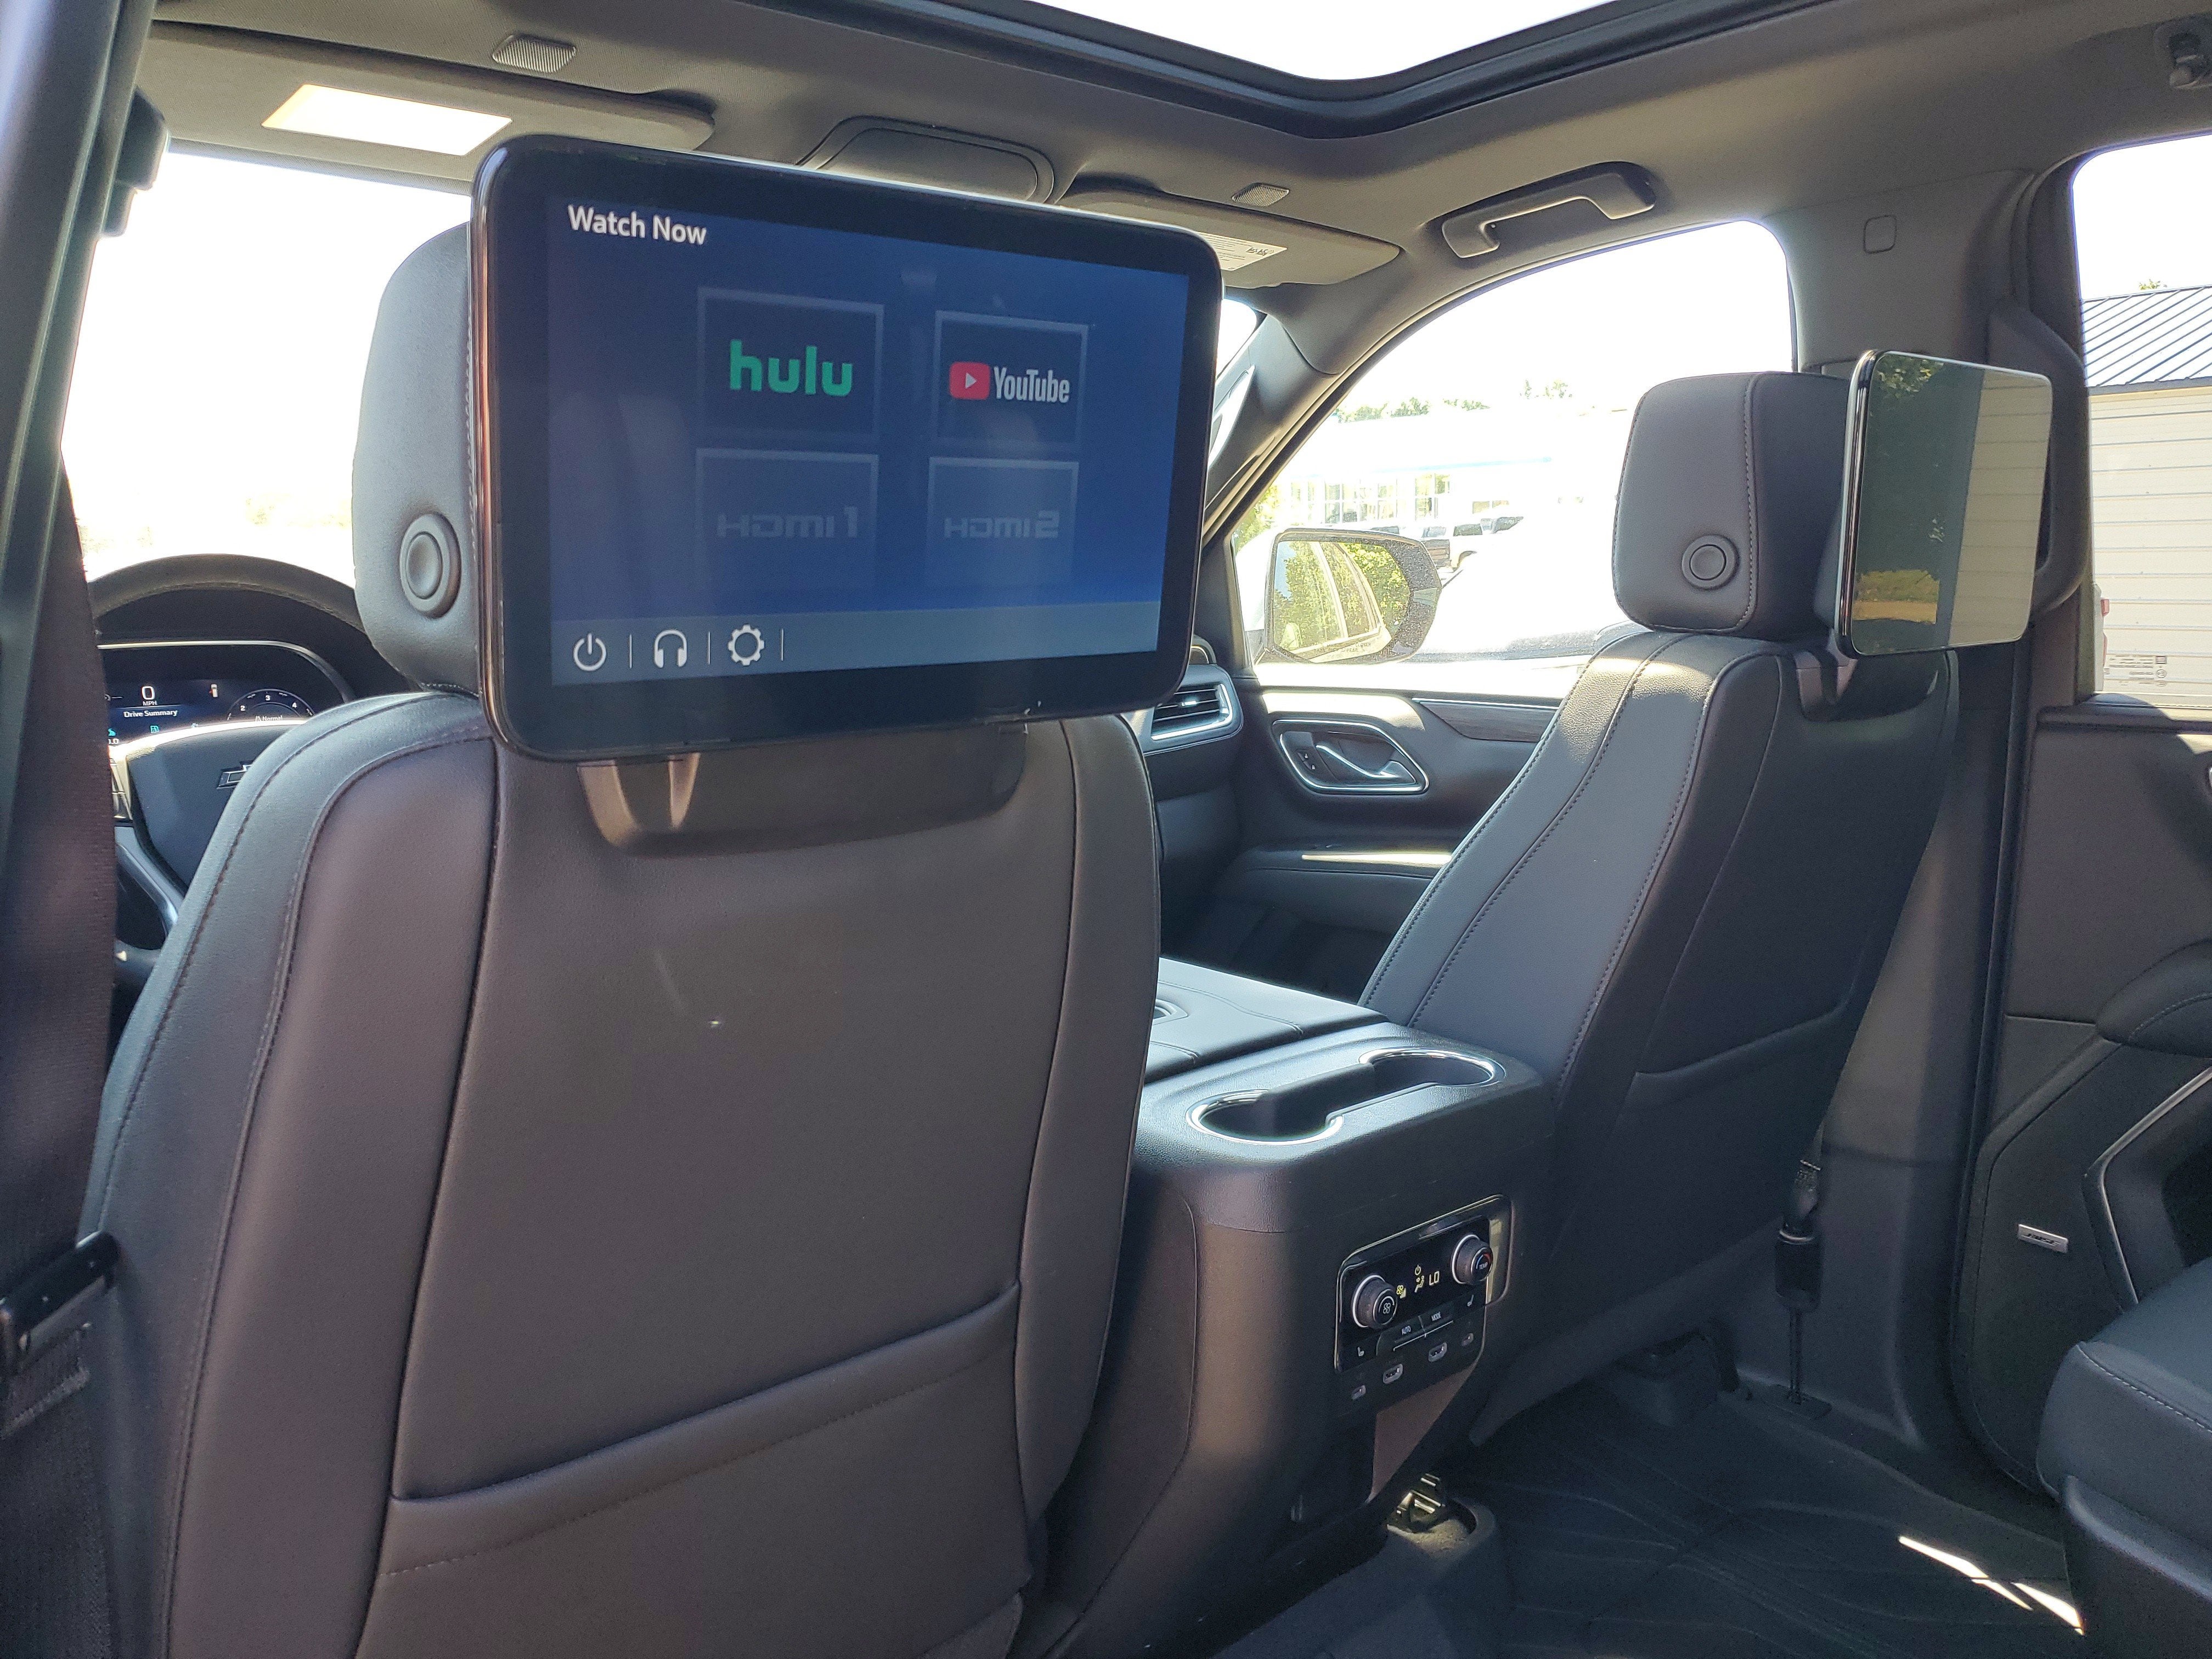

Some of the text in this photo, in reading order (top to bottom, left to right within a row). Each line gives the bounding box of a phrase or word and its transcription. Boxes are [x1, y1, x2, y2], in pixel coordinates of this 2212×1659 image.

[567, 204, 707, 245] Watch Now
[730, 340, 853, 396] hulu
[994, 366, 1069, 403] YouTube
[844, 506, 858, 538] 1
[1035, 510, 1059, 538] 2
[141, 686, 156, 701] 0
[1402, 1325, 1412, 1335] AUTO
[1431, 1312, 1442, 1322] MODE
